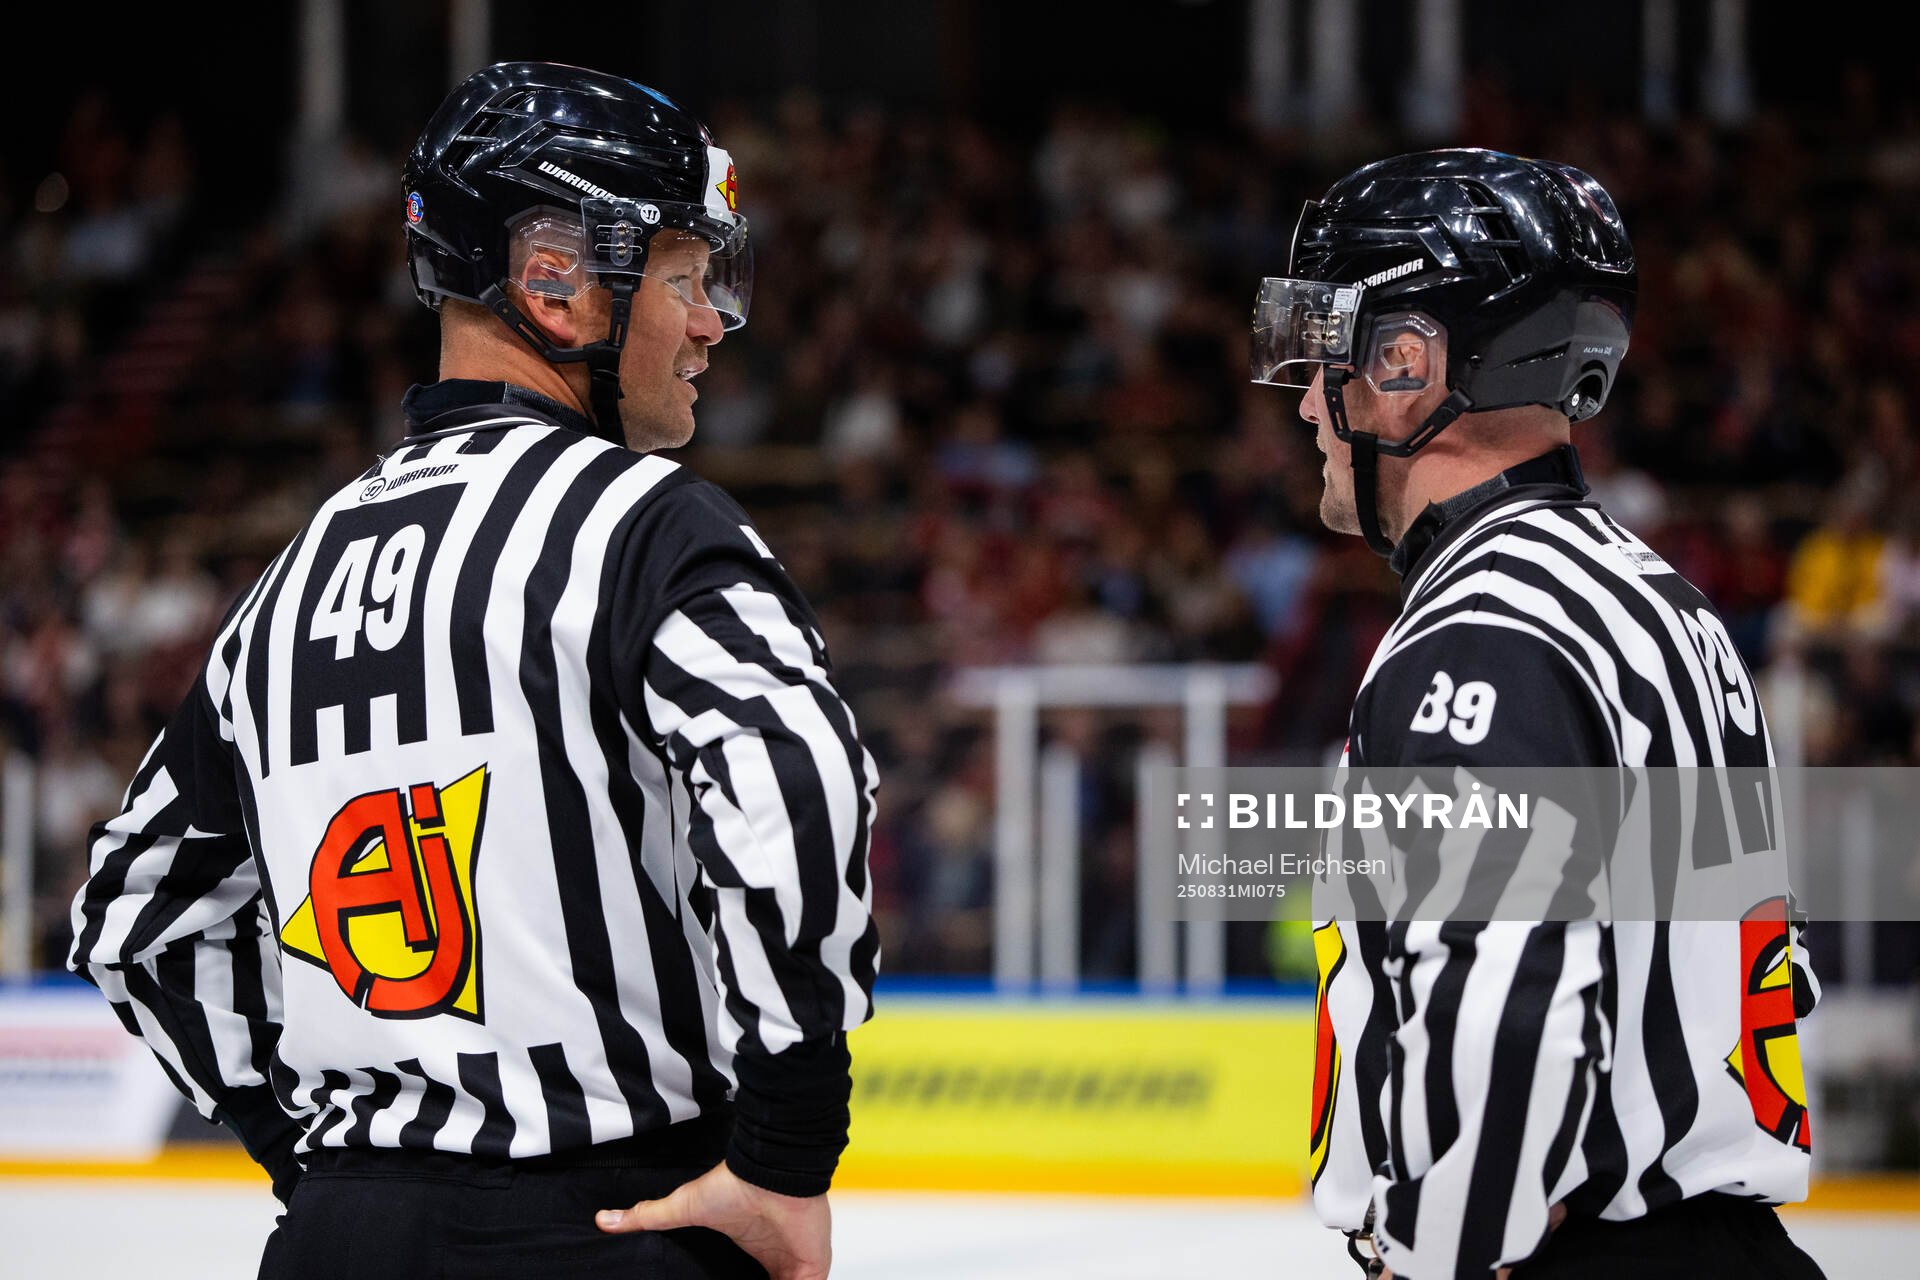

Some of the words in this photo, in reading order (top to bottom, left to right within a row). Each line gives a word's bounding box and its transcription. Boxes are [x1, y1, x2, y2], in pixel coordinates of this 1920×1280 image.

[538, 160, 619, 204] WARRIOR
[386, 463, 460, 491] WARRIOR
[309, 523, 426, 661] 49
